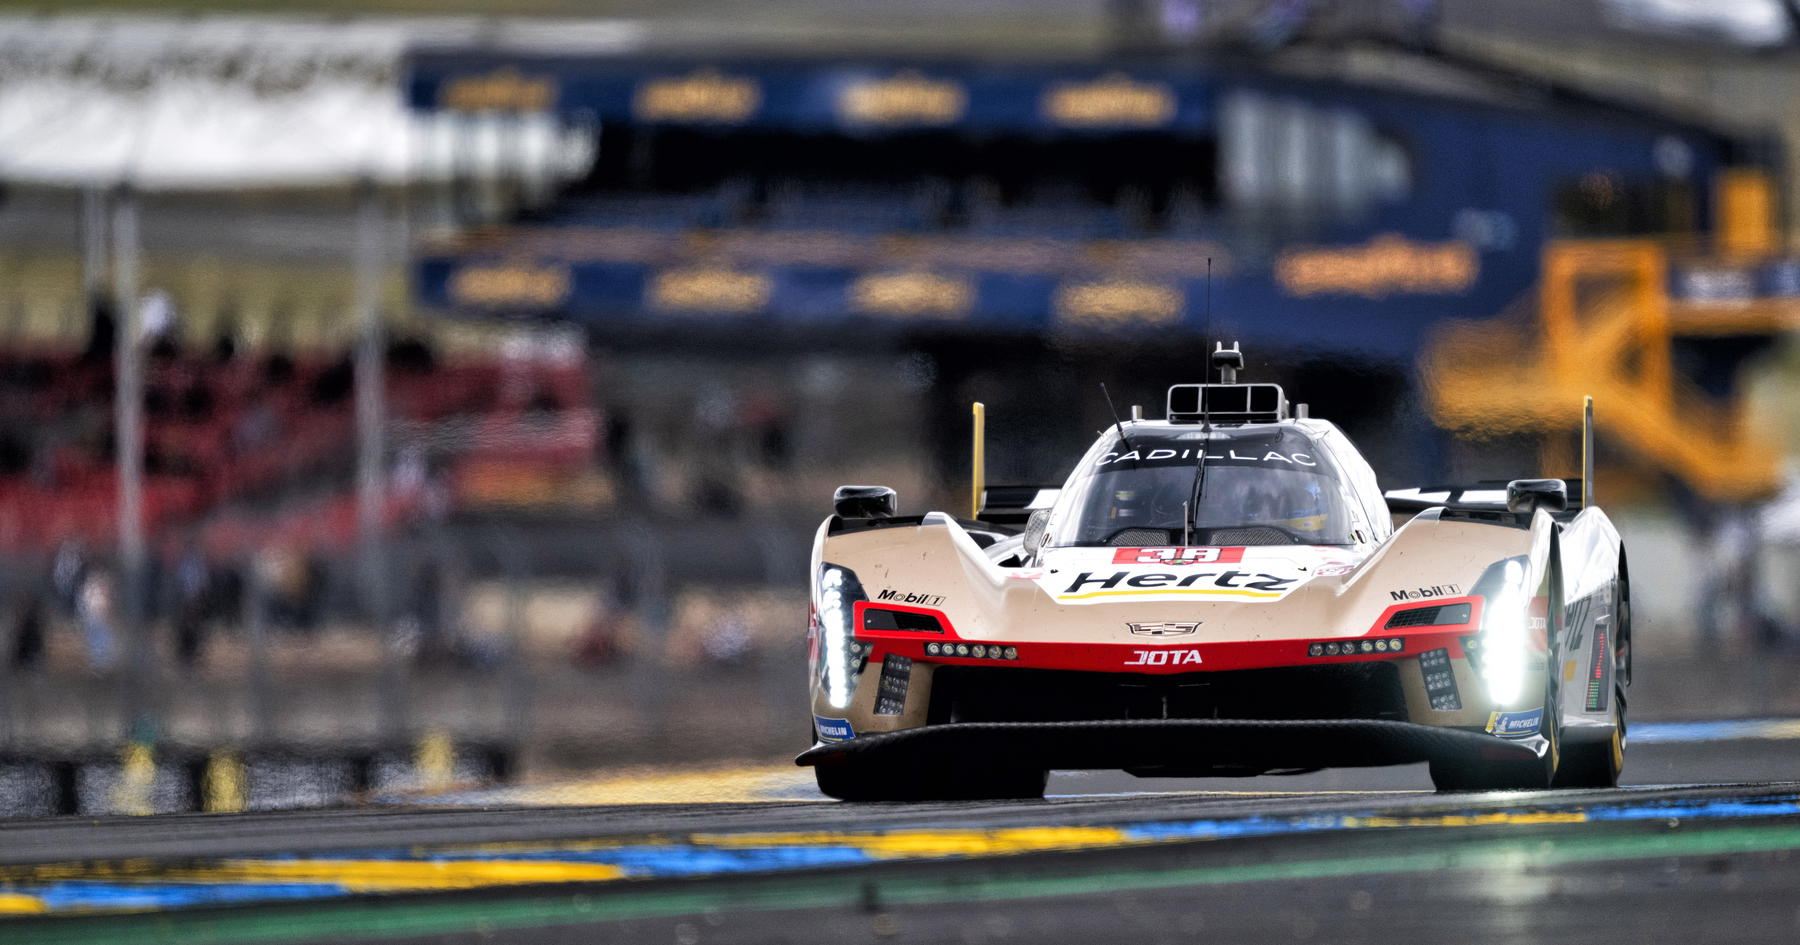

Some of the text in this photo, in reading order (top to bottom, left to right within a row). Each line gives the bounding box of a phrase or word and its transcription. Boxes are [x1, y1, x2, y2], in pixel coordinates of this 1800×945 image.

[1096, 448, 1317, 467] CADILLAC
[1137, 547, 1222, 563] 38
[1065, 570, 1298, 593] Hertz
[877, 589, 929, 604] Mobil
[1390, 586, 1443, 601] Mobil
[1124, 649, 1203, 665] JOTA
[1508, 717, 1540, 729] MICHELIN
